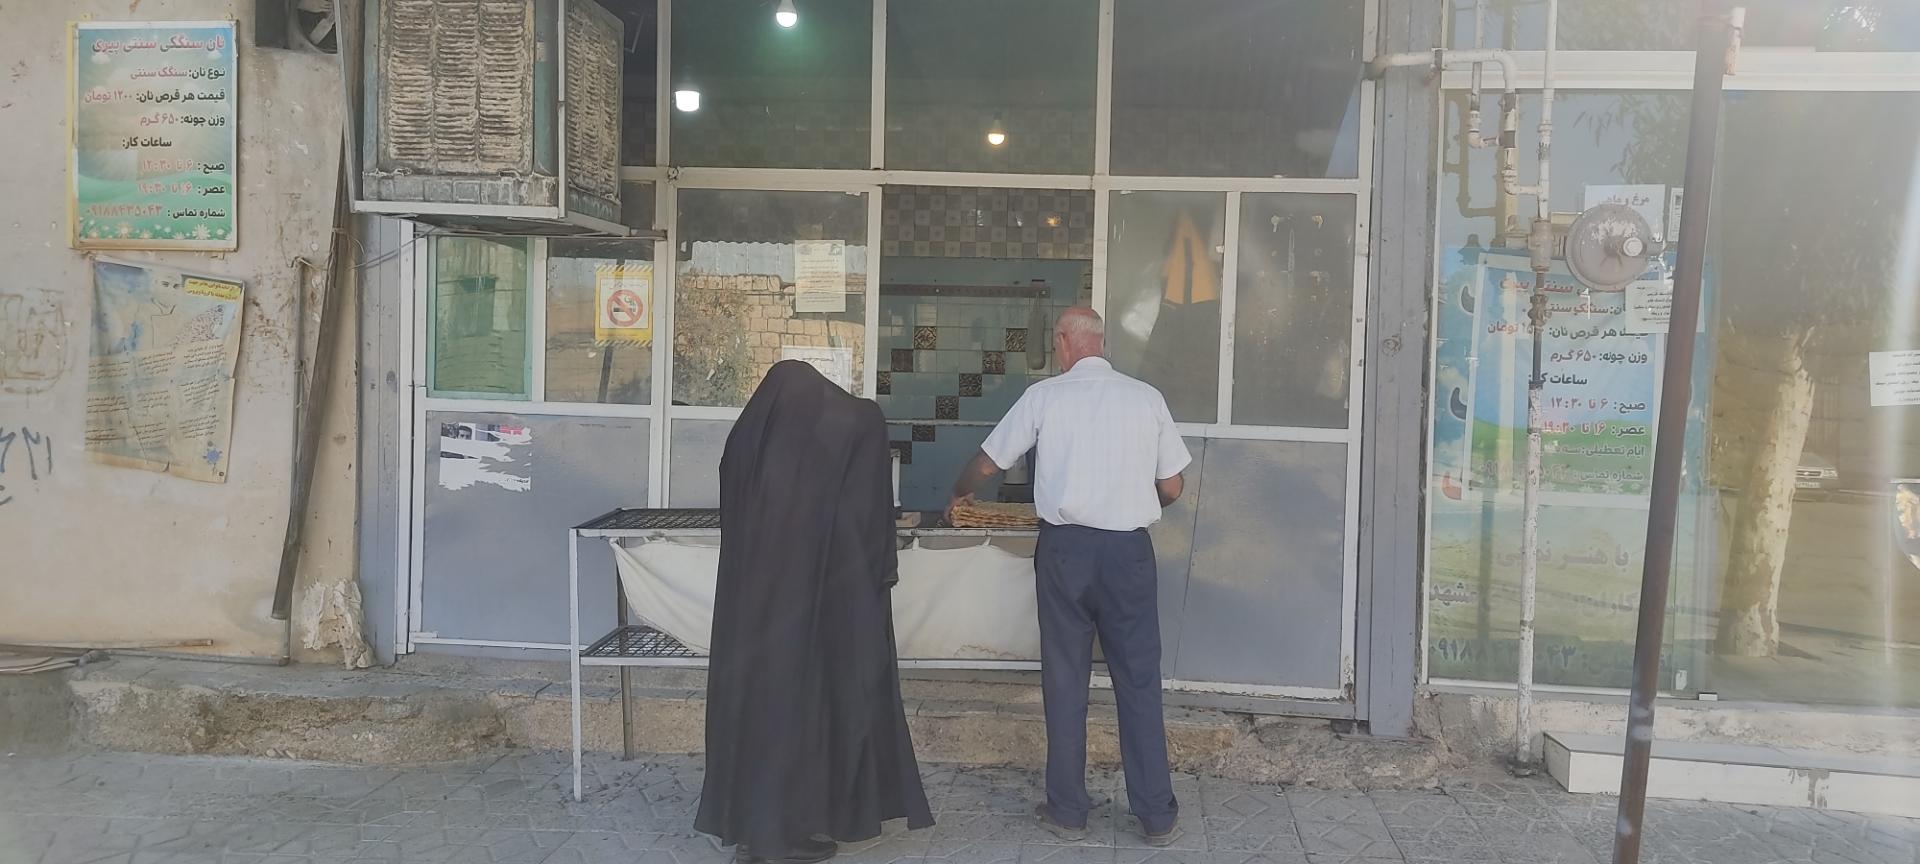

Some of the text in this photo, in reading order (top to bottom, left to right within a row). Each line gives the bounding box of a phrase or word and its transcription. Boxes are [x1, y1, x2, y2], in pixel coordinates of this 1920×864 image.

[91, 39, 120, 55] پیری
[123, 38, 157, 53] سنتی
[206, 34, 225, 52] نان
[130, 66, 226, 80] نوع نان: سنگک سنتی
[84, 89, 112, 103] تومان
[136, 90, 154, 103] نان:
[155, 88, 180, 103] قرص
[181, 91, 195, 103] هر
[197, 88, 226, 103] قیمت
[140, 112, 226, 127] وزن چونه: ۶۵۰ گرم
[122, 136, 172, 149] ساعات کار:
[176, 159, 182, 170] تا
[185, 160, 193, 170] ۶
[1631, 191, 1651, 207] مرغ
[199, 208, 226, 219] شماره
[1549, 325, 1568, 339] نان:
[1570, 325, 1599, 341] قرص
[1600, 326, 1617, 340] هر
[1550, 348, 1648, 365] وزن چونه: ۶۵۰ گرم
[1549, 372, 1588, 385] ساعات
[1550, 396, 1582, 410] ۱۲:۳۰
[1588, 397, 1597, 410] تا
[1599, 397, 1609, 411] ۶
[1580, 420, 1590, 434] تا
[1594, 420, 1607, 434] ۱۶
[1626, 445, 1645, 458] ایام
[1559, 547, 1609, 570] هنر
[1612, 544, 1630, 572] با
